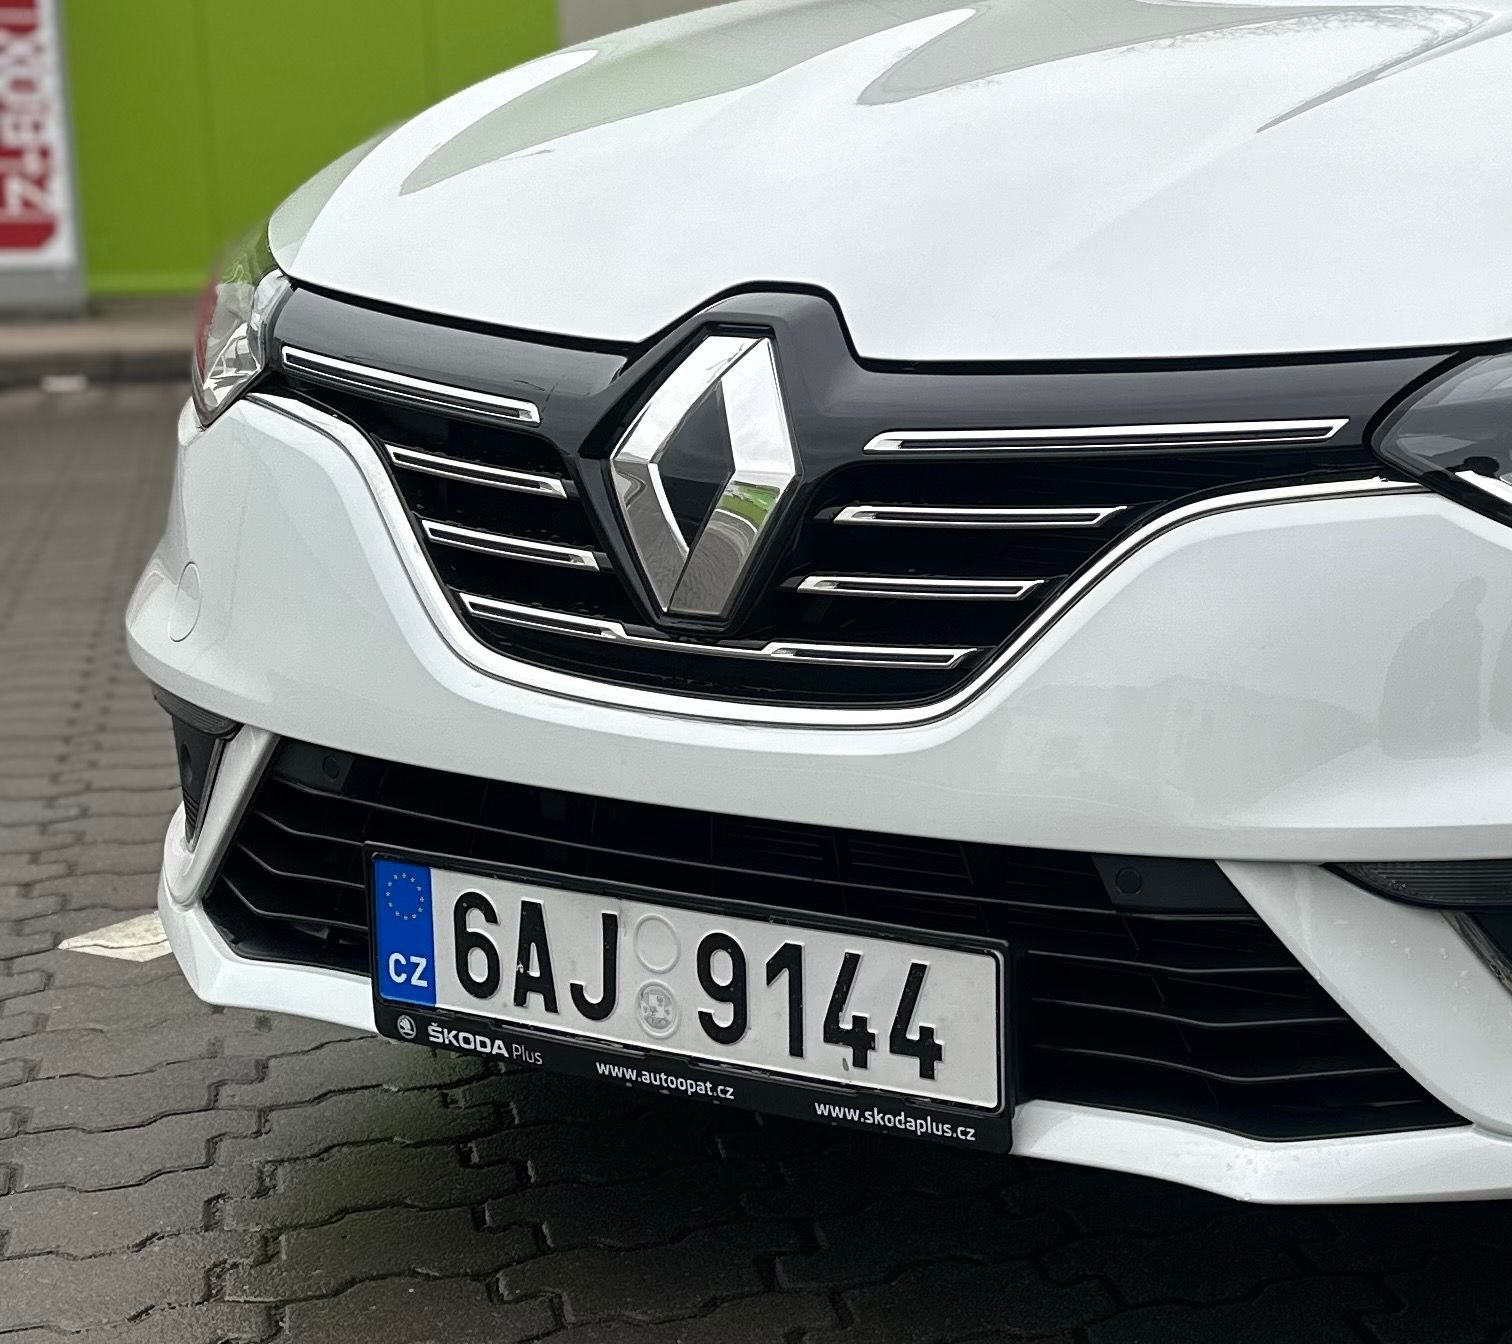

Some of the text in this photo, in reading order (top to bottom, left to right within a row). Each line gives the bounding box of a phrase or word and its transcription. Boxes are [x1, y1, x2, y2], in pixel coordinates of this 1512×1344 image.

[388, 952, 429, 988] CZ
[453, 890, 944, 1081] 6AJ 9144
[427, 1022, 543, 1065] ŠKODA Plus
[595, 1061, 735, 1100] www.autoopat.cz
[814, 1102, 976, 1141] www.skodaplus.cz
